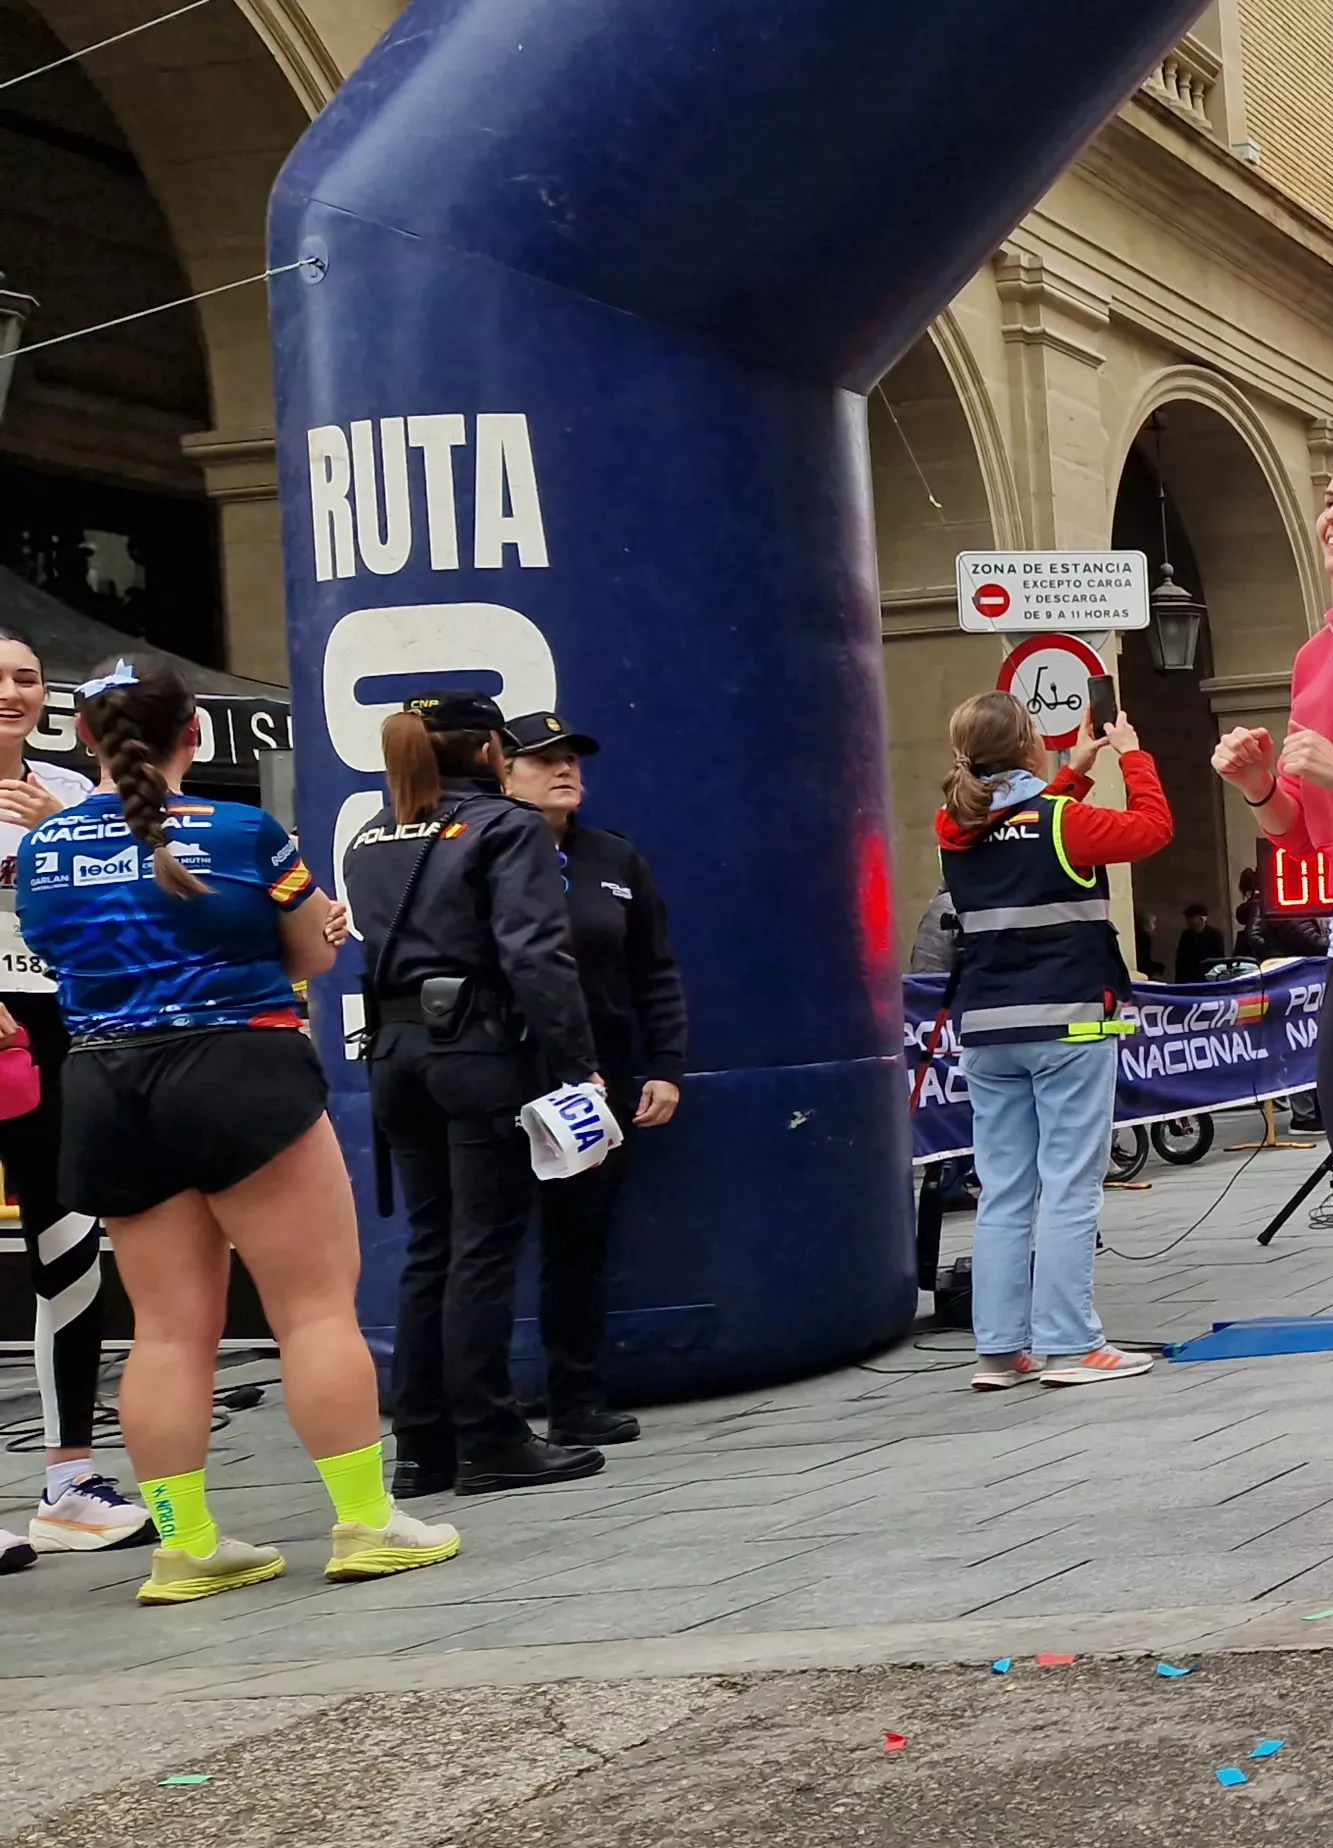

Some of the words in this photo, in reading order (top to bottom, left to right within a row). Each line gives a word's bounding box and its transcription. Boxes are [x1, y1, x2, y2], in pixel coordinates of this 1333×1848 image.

[307, 413, 550, 582] RUTA
[971, 563, 1017, 575] ZONA
[1023, 563, 1043, 574] DE
[1050, 562, 1132, 574] ESTANCIA
[1023, 579, 1082, 589] EXCEPTO
[1087, 579, 1132, 588] CARGA
[1024, 594, 1031, 603] Y
[1036, 594, 1107, 604] DESCARGA
[1024, 610, 1040, 620] DE
[1045, 610, 1052, 620] 9
[1057, 610, 1066, 619] A
[1071, 610, 1080, 619] 11
[1085, 609, 1130, 619] HORAS
[410, 699, 440, 710] CNP
[30, 815, 213, 847] NACIOAL
[2, 953, 42, 973] 158
[1120, 1030, 1269, 1081] NACIONAL
[155, 1500, 175, 1523] RUN
